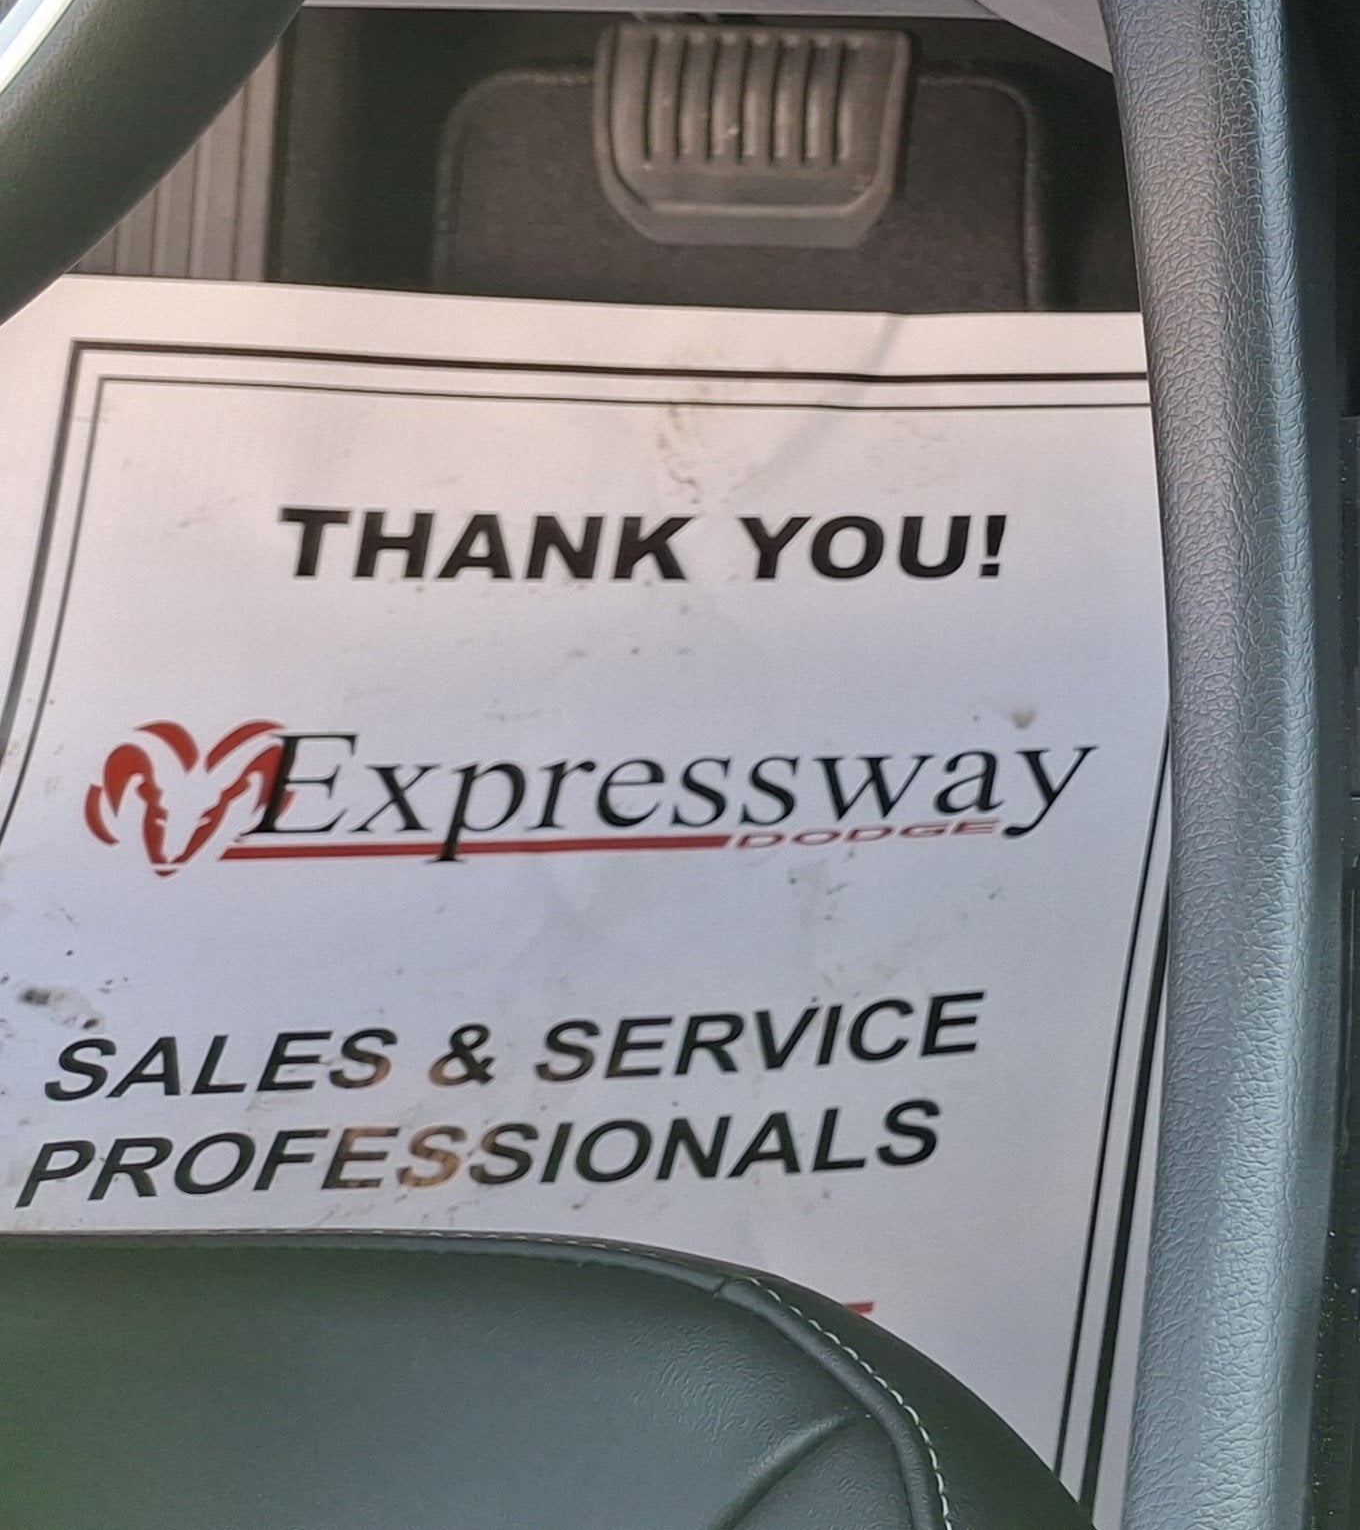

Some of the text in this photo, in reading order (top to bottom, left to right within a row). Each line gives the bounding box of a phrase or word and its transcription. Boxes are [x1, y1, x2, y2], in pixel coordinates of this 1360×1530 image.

[282, 508, 1006, 580] THANK YOU!
[243, 733, 1097, 863] Expressway
[733, 820, 1002, 849] DODGE
[44, 990, 986, 1101] SALES & SERVICE
[14, 1097, 943, 1208] PROFESSIONALS
